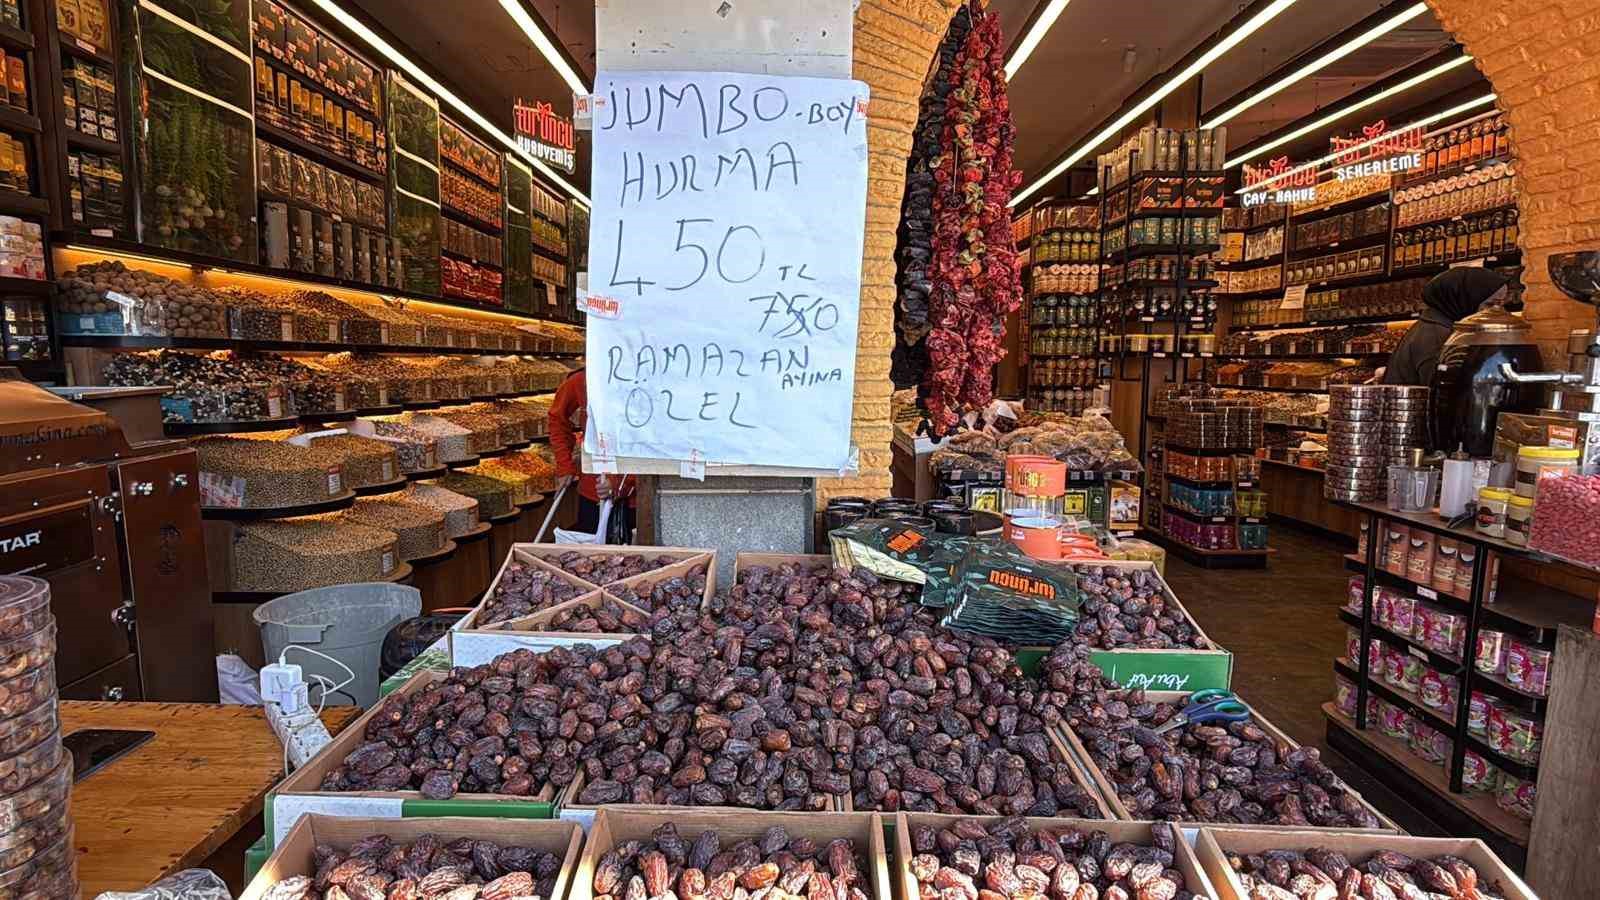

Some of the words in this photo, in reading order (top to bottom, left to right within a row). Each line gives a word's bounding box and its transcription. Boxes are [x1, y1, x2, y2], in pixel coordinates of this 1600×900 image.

[621, 142, 803, 208] HURMA
[609, 218, 766, 296] 450
[778, 263, 817, 282] TL
[608, 342, 810, 384] RAMAZAN
[781, 368, 843, 390] AYINA
[624, 377, 758, 428] ÖZEL
